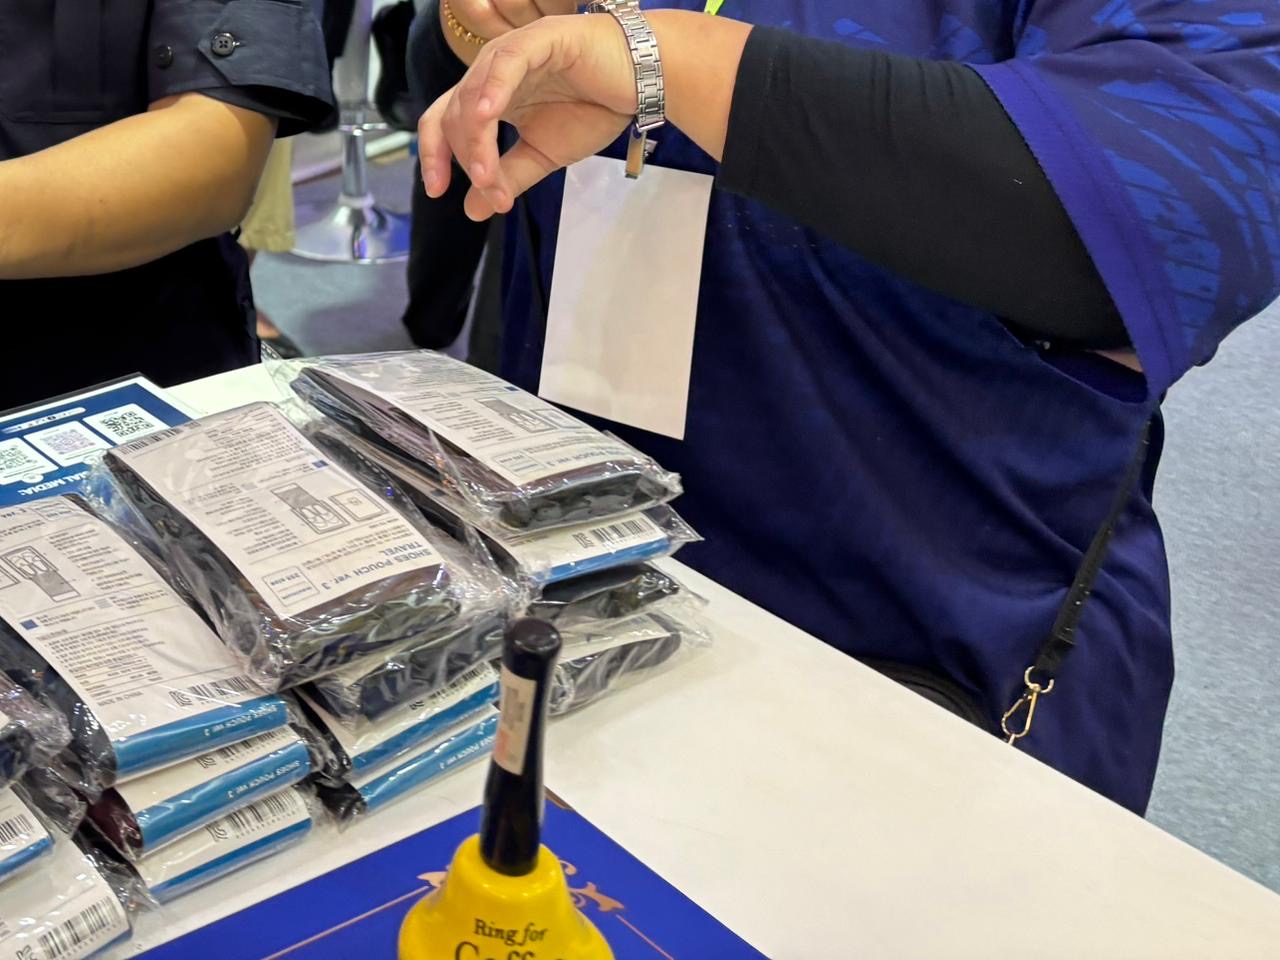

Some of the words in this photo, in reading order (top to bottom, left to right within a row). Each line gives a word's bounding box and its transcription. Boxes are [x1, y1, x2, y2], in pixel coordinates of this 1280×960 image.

[379, 540, 423, 556] TRAVEL
[396, 548, 432, 563] SHOES
[353, 559, 394, 576] POUCH
[321, 582, 331, 590] 3
[473, 917, 518, 947] Ring
[517, 922, 548, 947] for
